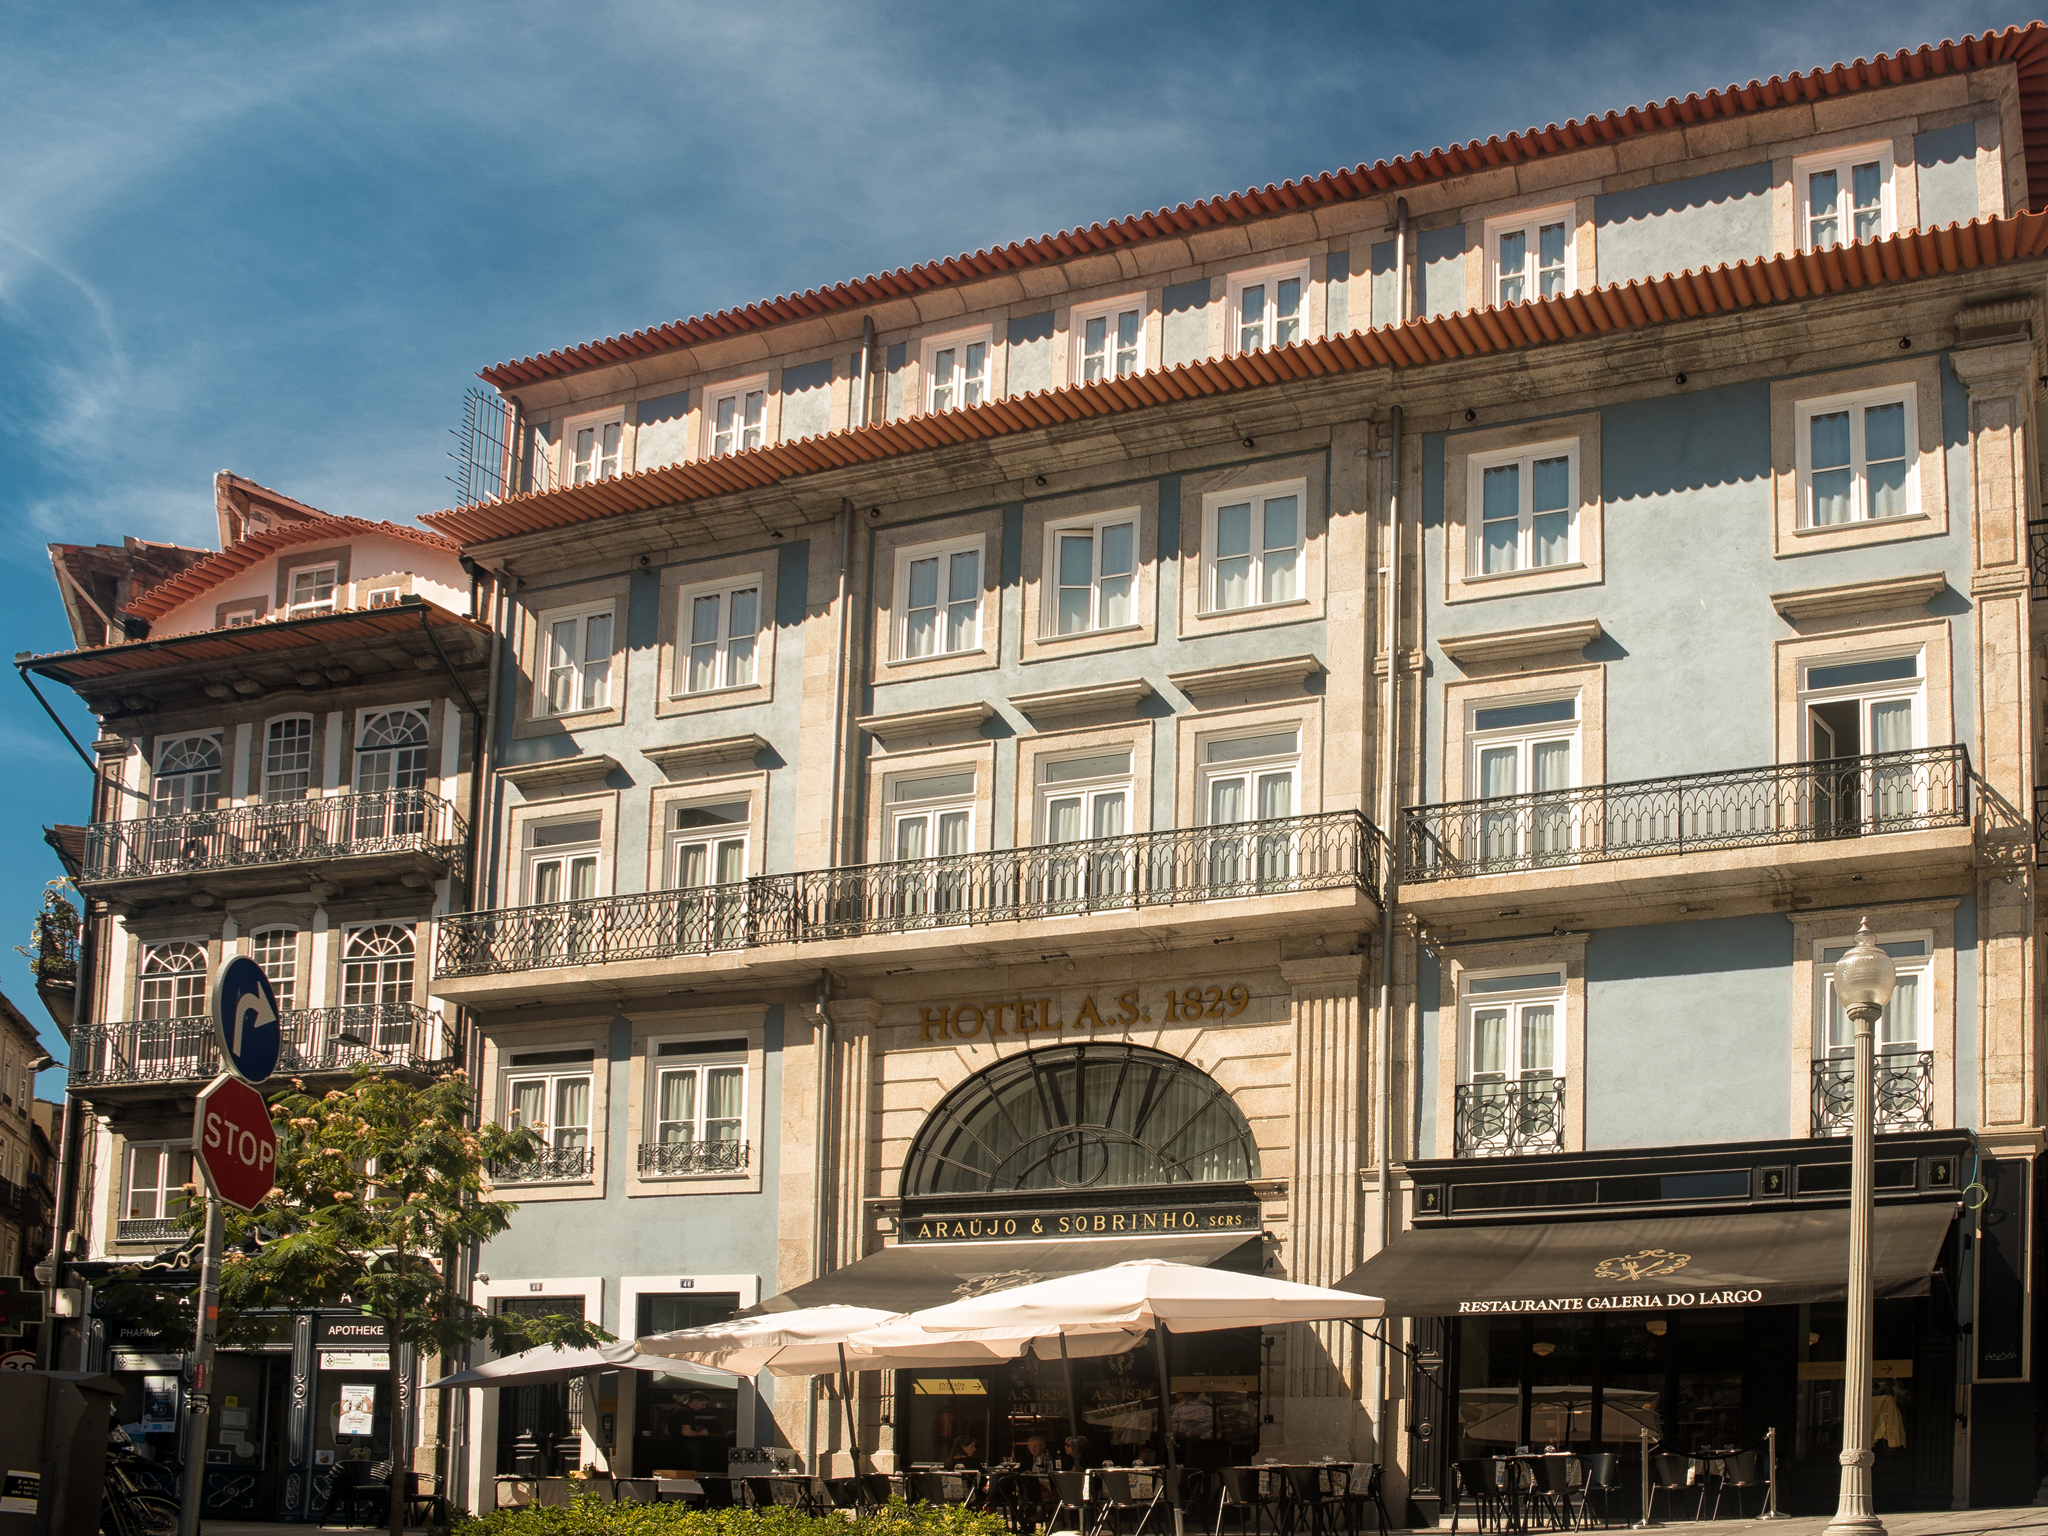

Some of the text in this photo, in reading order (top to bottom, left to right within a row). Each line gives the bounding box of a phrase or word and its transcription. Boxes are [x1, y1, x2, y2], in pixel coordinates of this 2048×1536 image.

[918, 984, 1249, 1040] HOTEL A.S. 1829
[204, 1112, 274, 1171] STOP
[918, 1211, 1242, 1238] ARAÚJO & SOBRINHO, SCRS
[1458, 1289, 1762, 1313] RESTAURANTE GALERIA DO LARGO
[328, 1325, 384, 1336] APOTHEKE
[1037, 1389, 1066, 1400] 1829
[1121, 1388, 1151, 1400] 1829
